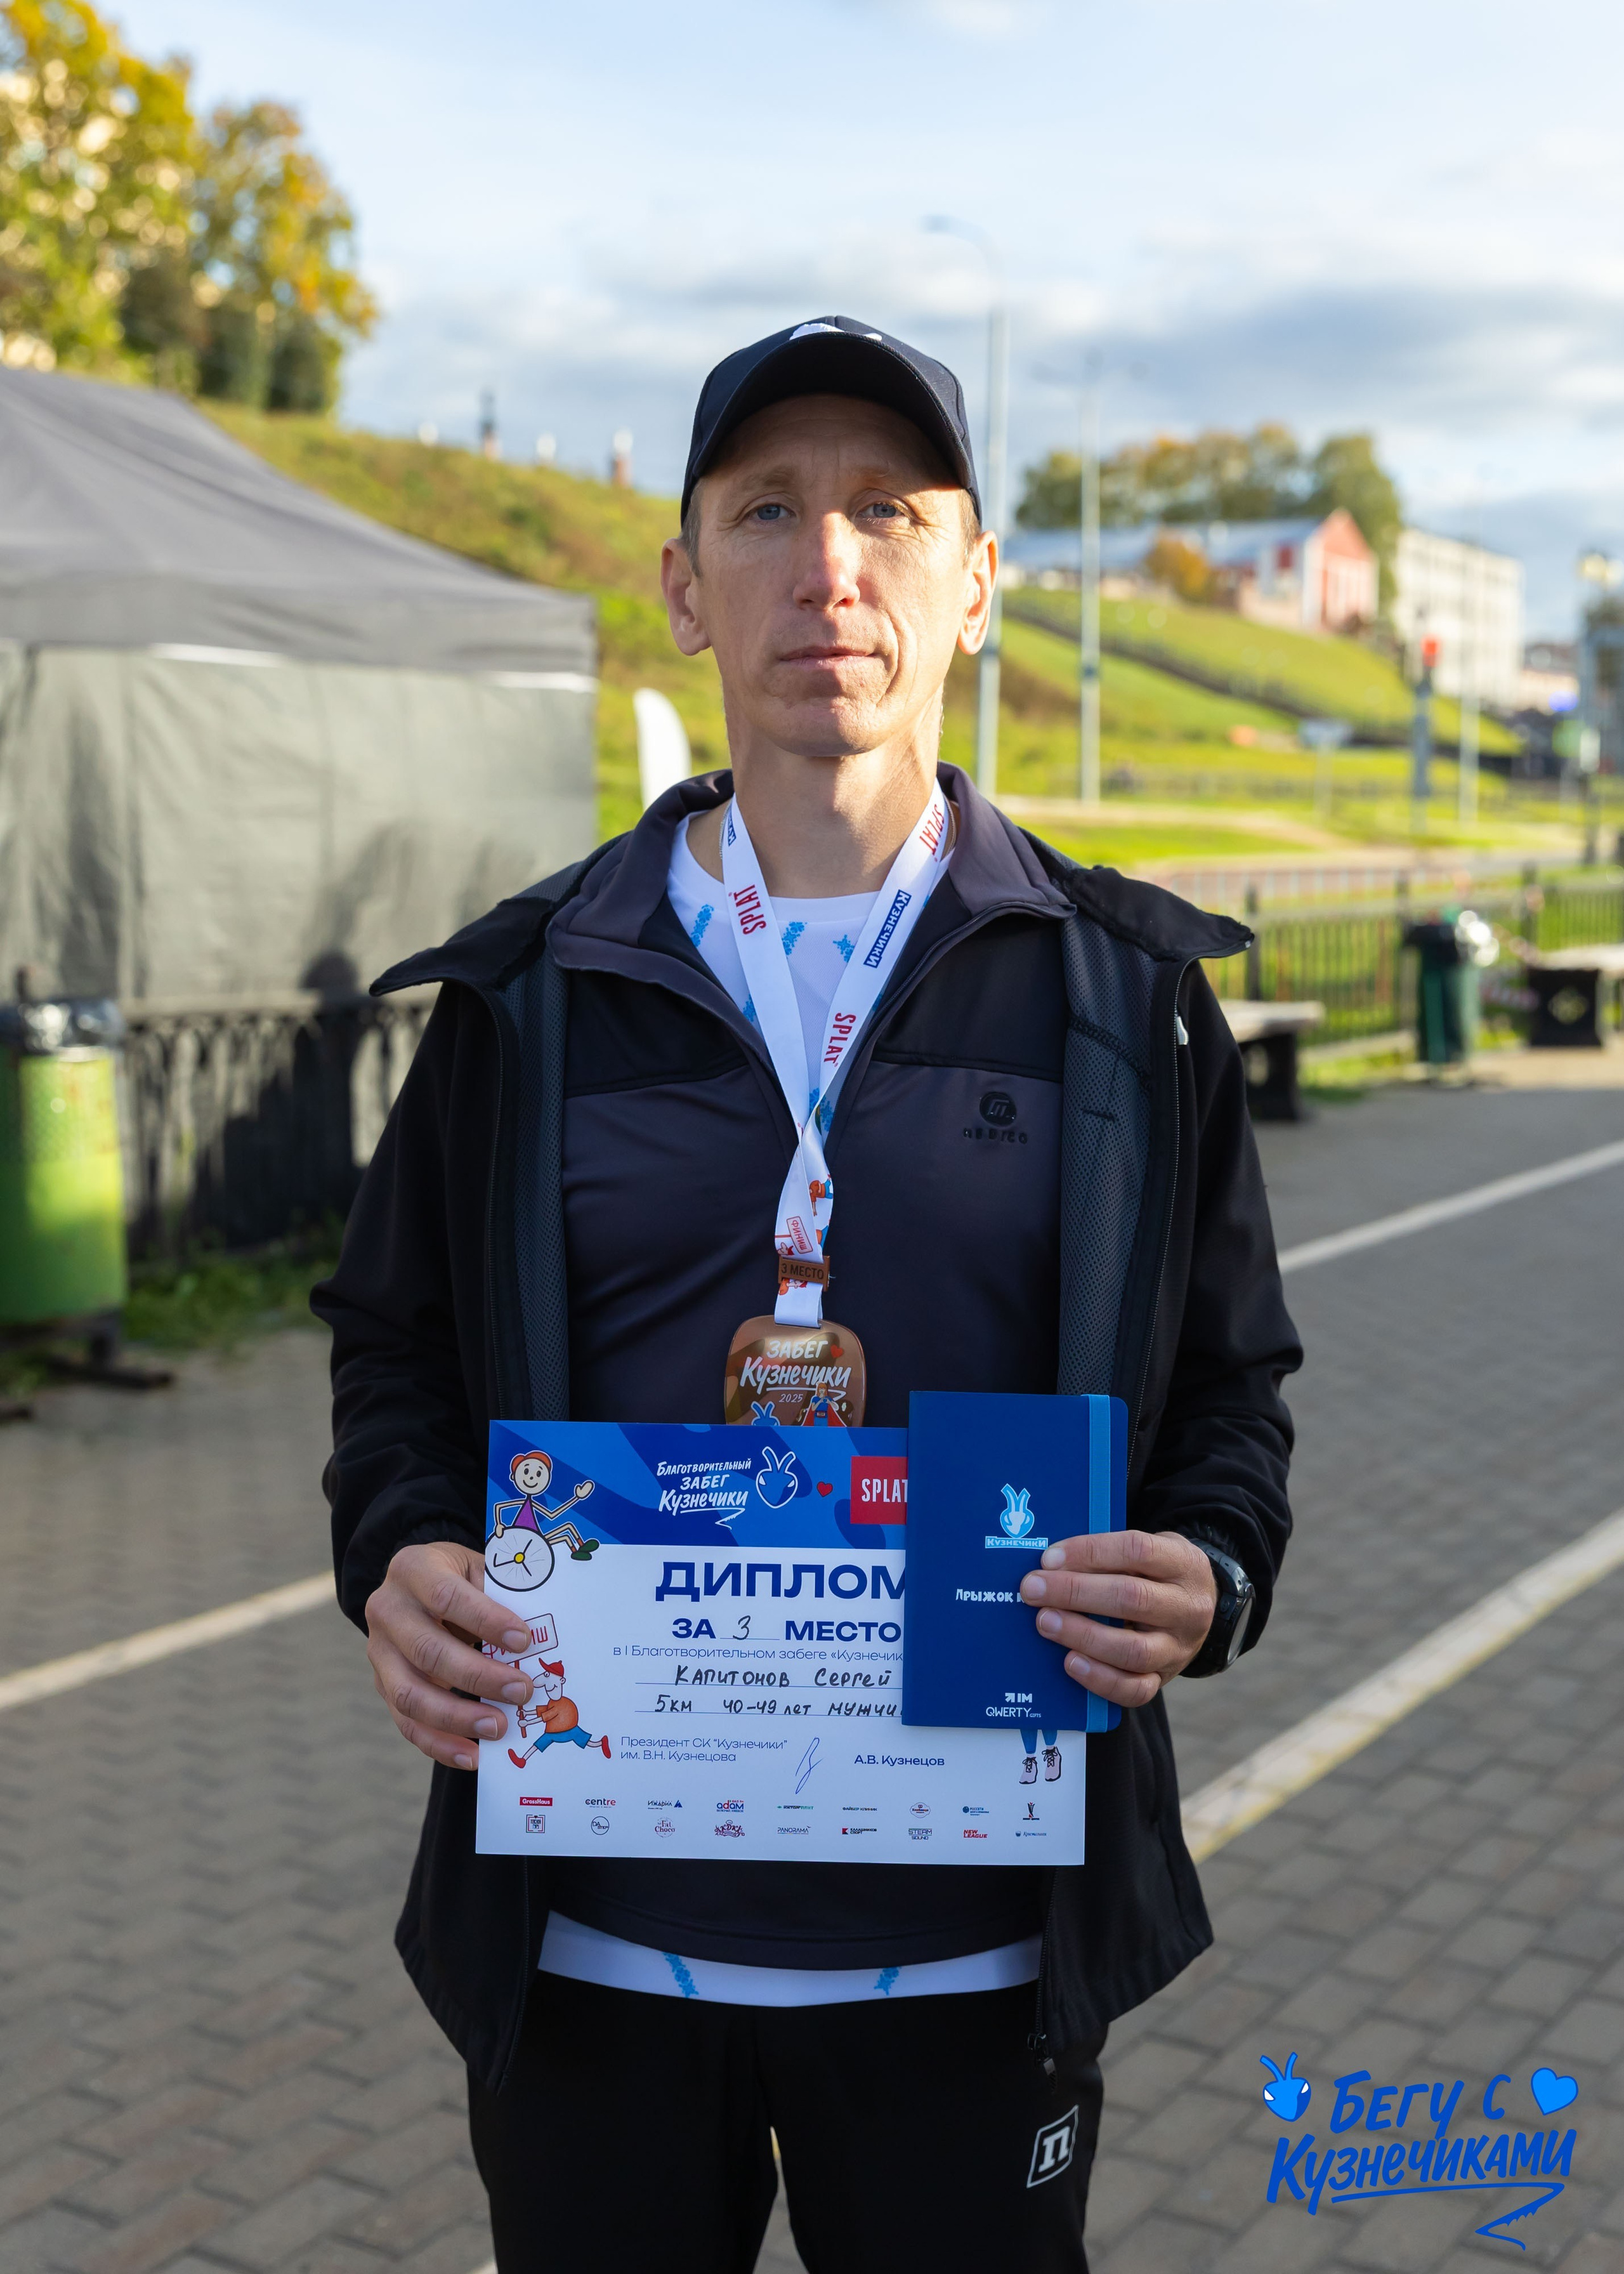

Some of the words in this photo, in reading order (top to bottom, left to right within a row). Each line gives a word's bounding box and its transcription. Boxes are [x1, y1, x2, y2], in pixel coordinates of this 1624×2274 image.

[919, 804, 945, 856] SPLAT
[733, 884, 767, 935] SPLAT
[865, 890, 911, 968] КУЗНЕЧИКИ
[824, 1012, 856, 1065] SPLAT
[790, 1219, 807, 1251] ФИНИШ
[781, 1263, 787, 1273] 3
[790, 1264, 825, 1280] МЕСТО
[766, 1340, 828, 1359] ЗАБЕГ
[740, 1356, 852, 1395] Кузнечики
[778, 1393, 804, 1403] 2025
[680, 1474, 730, 1490] ЗАБЕГ
[658, 1490, 749, 1516] Кузнечики
[986, 1537, 1047, 1549] КУЗНЕЧИКИ
[655, 1561, 906, 1603] ДИПЛОМ
[672, 1618, 716, 1640] ЗА
[732, 1615, 752, 1641] 3
[785, 1620, 902, 1642] МЕСТО
[613, 1646, 622, 1655] в
[631, 1645, 776, 1660] Благотворительном
[778, 1649, 827, 1662] забеге
[674, 1664, 790, 1688] КАПИТОНОВ
[723, 1699, 777, 1715] 40-49
[783, 1704, 812, 1716] лет
[985, 1707, 1032, 1718] QWERTY
[621, 1737, 690, 1749] Президент
[692, 1738, 711, 1749] СК
[620, 1752, 641, 1761] им.
[643, 1751, 666, 1761] В.Н.
[668, 1751, 737, 1763] Кузнецова
[854, 1754, 879, 1765] А.В.
[881, 1755, 945, 1766] Кузнецов
